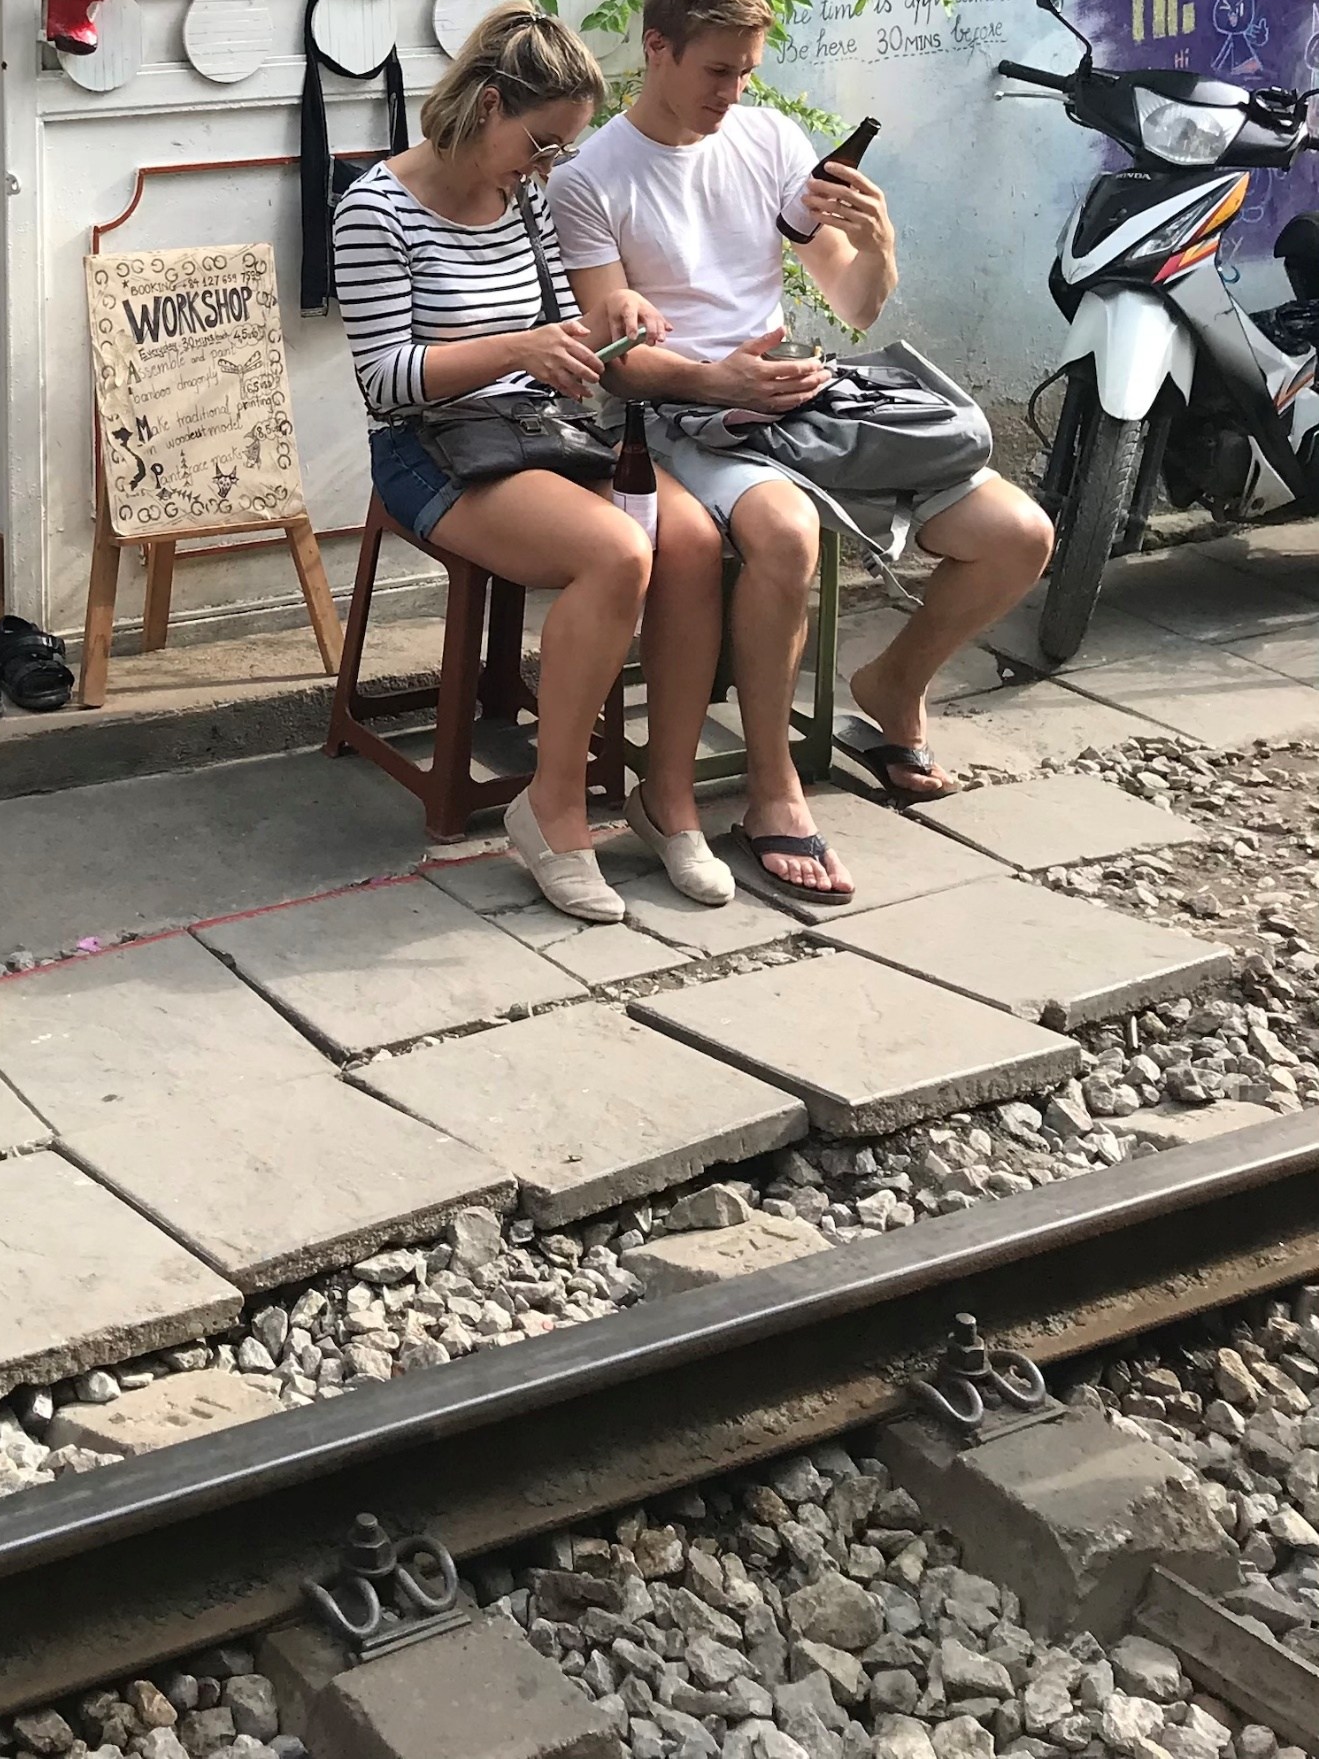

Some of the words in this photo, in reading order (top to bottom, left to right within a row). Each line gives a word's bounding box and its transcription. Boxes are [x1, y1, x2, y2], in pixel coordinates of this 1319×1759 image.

[816, 28, 857, 57] here
[950, 14, 1003, 47] before
[130, 282, 177, 297] BOOKING
[202, 275, 220, 287] 127
[122, 286, 253, 345] WORKSHOP
[127, 349, 186, 384] Assemble
[191, 349, 206, 363] and
[133, 384, 171, 404] bamboo
[177, 367, 219, 394] dragonfly
[136, 414, 170, 444] Make
[176, 394, 230, 427] traditional
[237, 394, 274, 422] printing
[211, 446, 243, 465] masks
